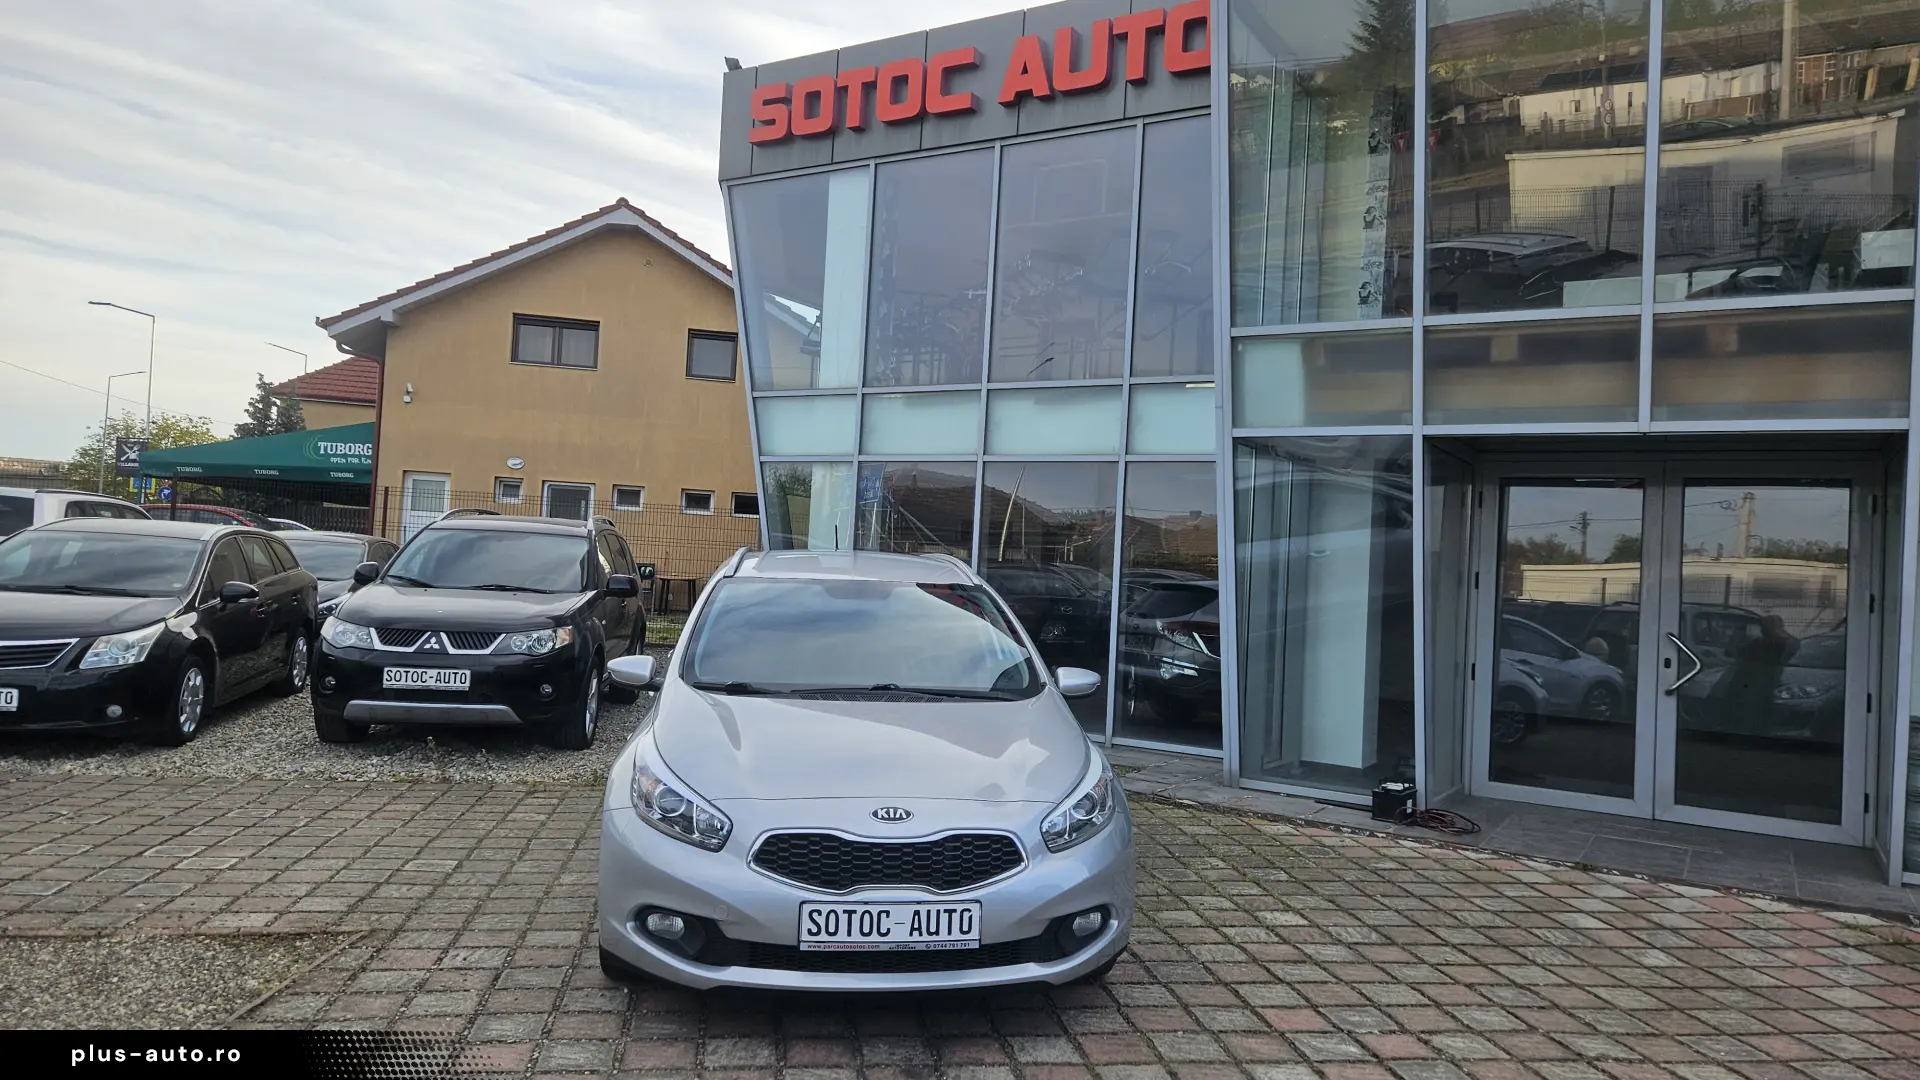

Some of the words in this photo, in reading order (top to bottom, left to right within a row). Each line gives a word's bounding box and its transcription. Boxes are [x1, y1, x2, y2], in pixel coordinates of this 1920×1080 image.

[749, 47, 980, 144] SOTOC
[997, 1, 1211, 107] AUTO
[317, 441, 372, 455] TUBORG
[385, 669, 467, 684] SOTOC-AUTO
[877, 808, 907, 819] KIA
